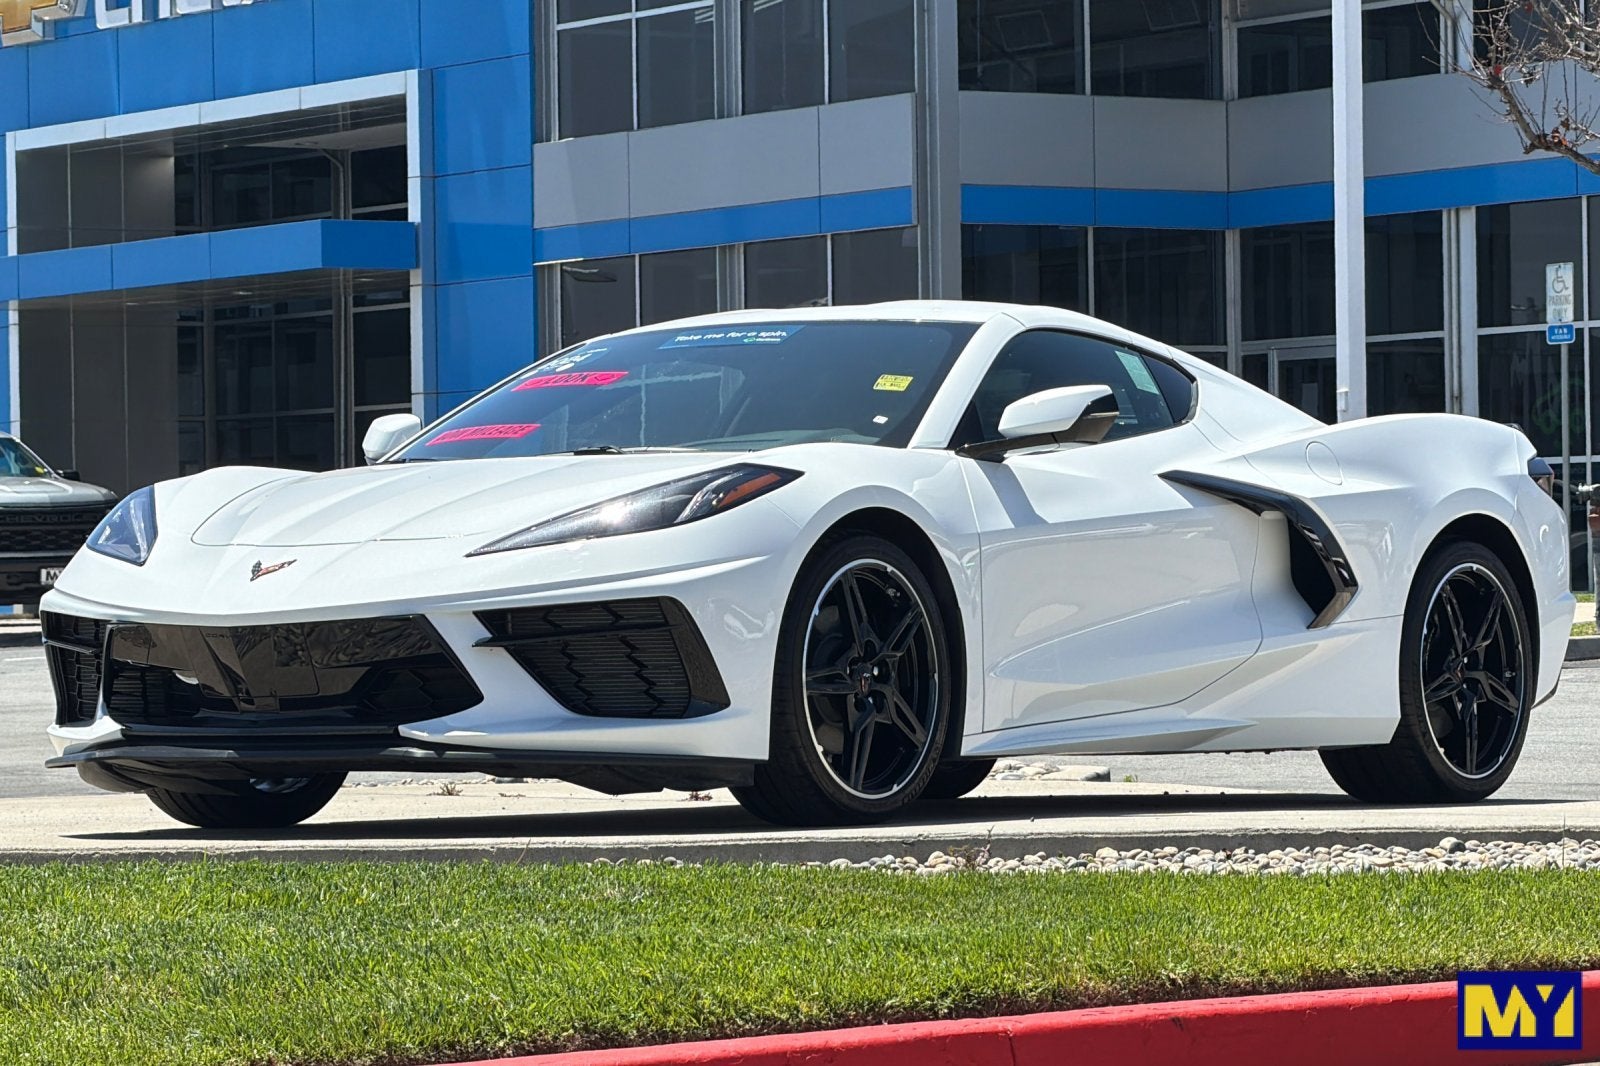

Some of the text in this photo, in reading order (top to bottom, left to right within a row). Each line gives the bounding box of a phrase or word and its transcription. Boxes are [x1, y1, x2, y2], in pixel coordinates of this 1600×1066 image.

[1548, 294, 1571, 306] PARKING
[1552, 307, 1568, 319] ONLY
[1554, 327, 1568, 335] VAN
